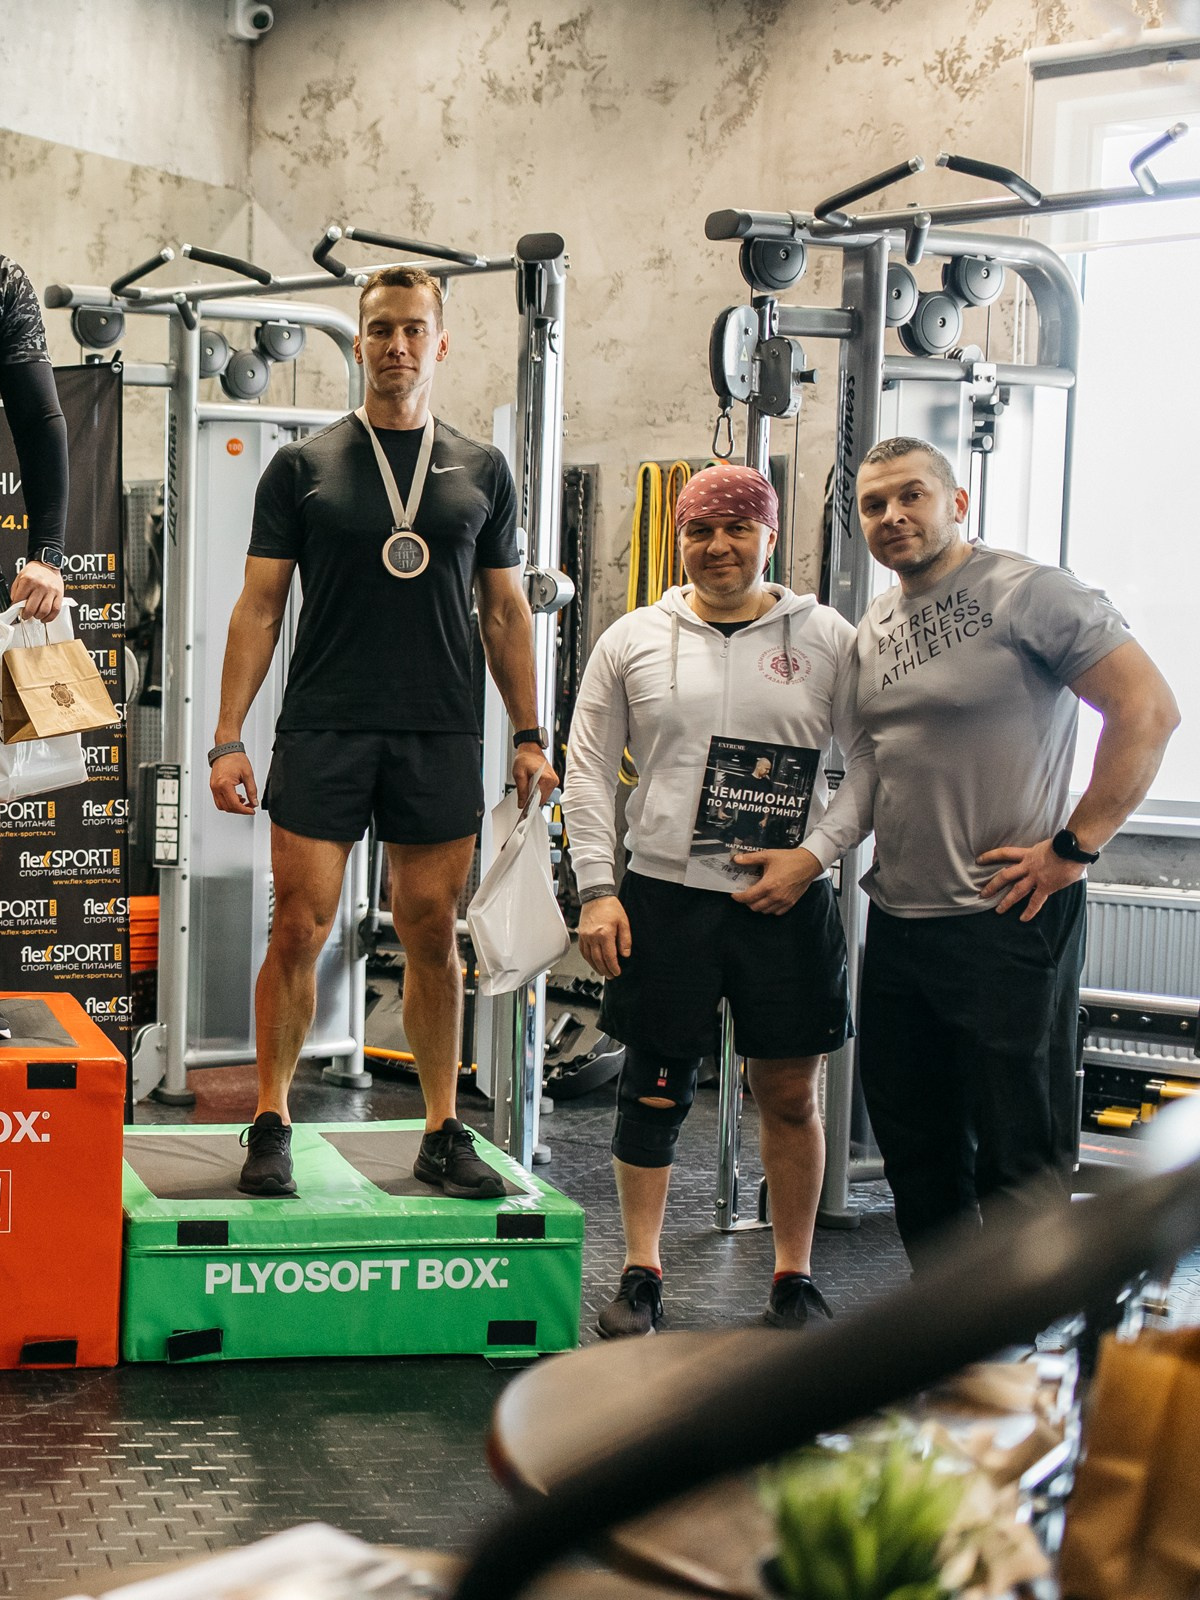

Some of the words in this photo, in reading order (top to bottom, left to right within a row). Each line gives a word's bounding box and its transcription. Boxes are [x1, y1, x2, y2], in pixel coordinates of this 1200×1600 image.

[75, 573, 116, 581] ПИТАНИЕ
[878, 588, 970, 655] EXTREME
[894, 599, 981, 661] FITNESS
[881, 612, 993, 690] ATHLETICS
[717, 742, 747, 751] EXTREME
[709, 784, 806, 809] ЧЕМПИОНАТ
[706, 798, 723, 808] ПО
[725, 801, 803, 818] АРМЛИФТИНГУ
[15, 820, 56, 828] ПИТАНИЕ
[19, 869, 78, 877] СПОРТИВНОЕ
[80, 868, 120, 876] ПИТАНИЕ
[16, 918, 57, 926] ПИТАНИЕ
[20, 964, 79, 972] СПОРТИВНОЕ
[81, 962, 122, 970] ПИТАНИЕ
[205, 1258, 410, 1295] PLYOSOFT
